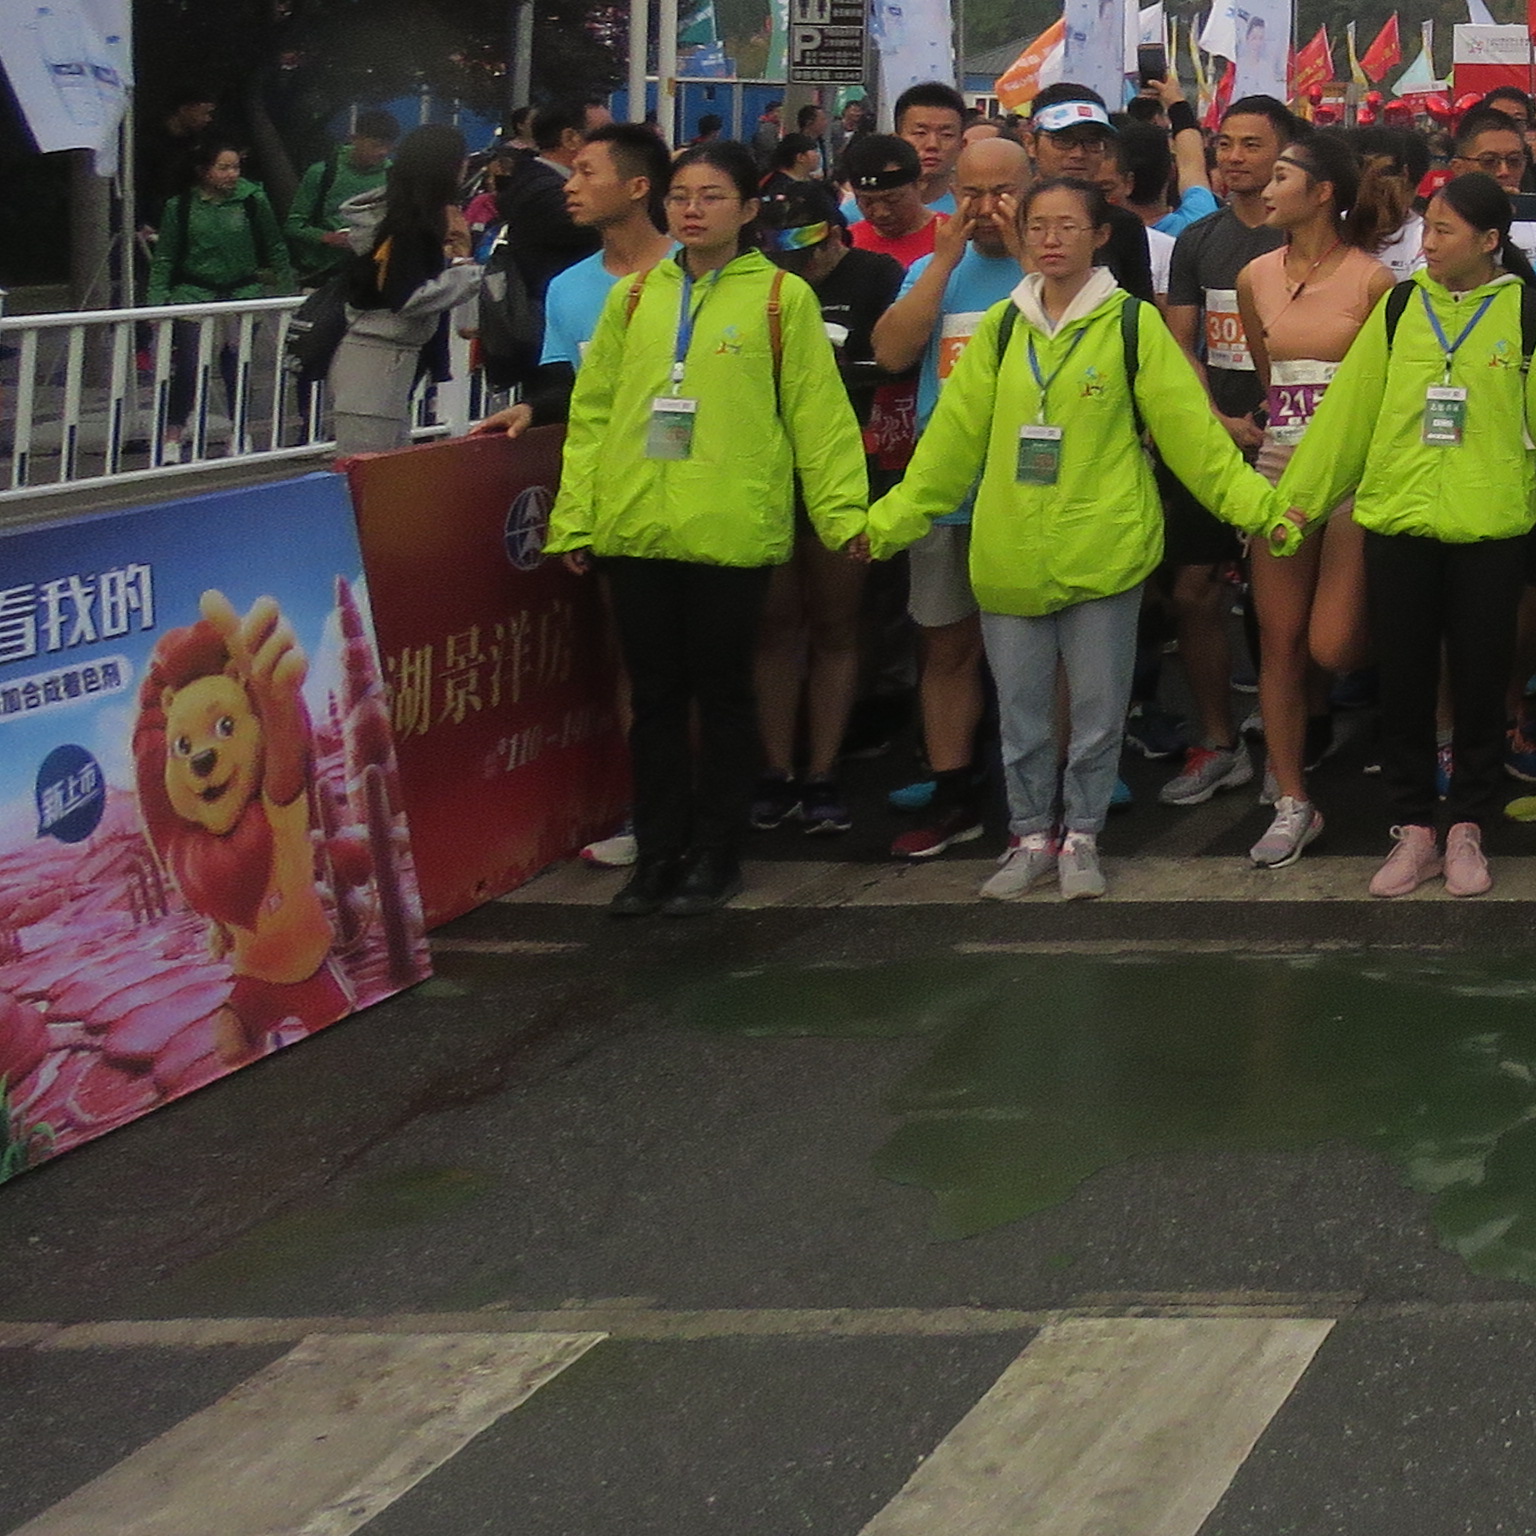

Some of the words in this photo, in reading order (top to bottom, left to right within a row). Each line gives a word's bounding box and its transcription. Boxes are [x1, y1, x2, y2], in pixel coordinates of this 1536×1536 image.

[1209, 316, 1247, 343] 30
[0, 563, 155, 664] 看我的
[41, 763, 99, 821] 新上市
